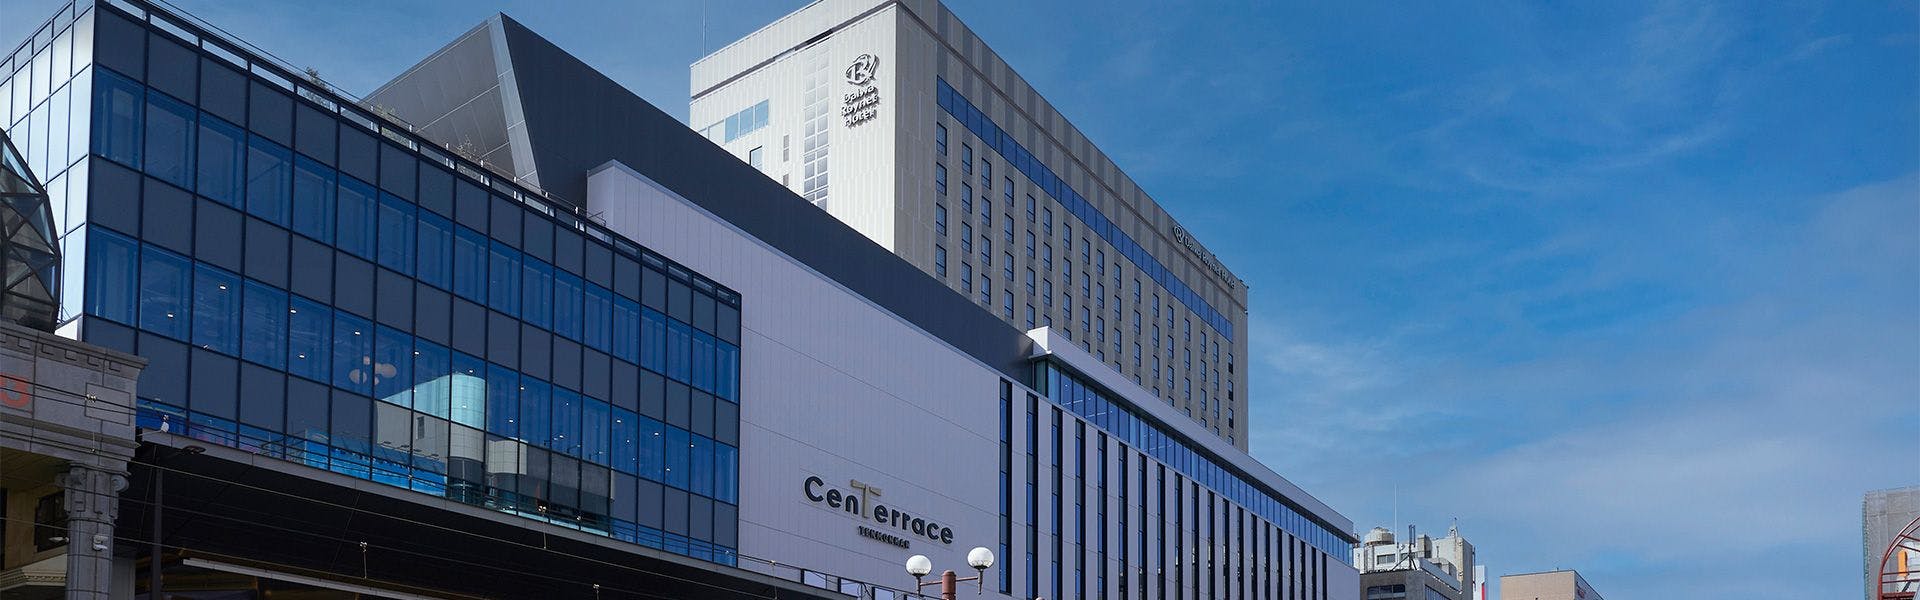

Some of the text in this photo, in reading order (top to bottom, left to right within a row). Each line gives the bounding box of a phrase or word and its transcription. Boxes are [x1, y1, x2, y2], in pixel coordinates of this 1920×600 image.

[841, 95, 880, 117] Roynet
[844, 86, 878, 105] Daiwa
[845, 107, 878, 129] Hotel
[804, 475, 955, 545] CenTerrace
